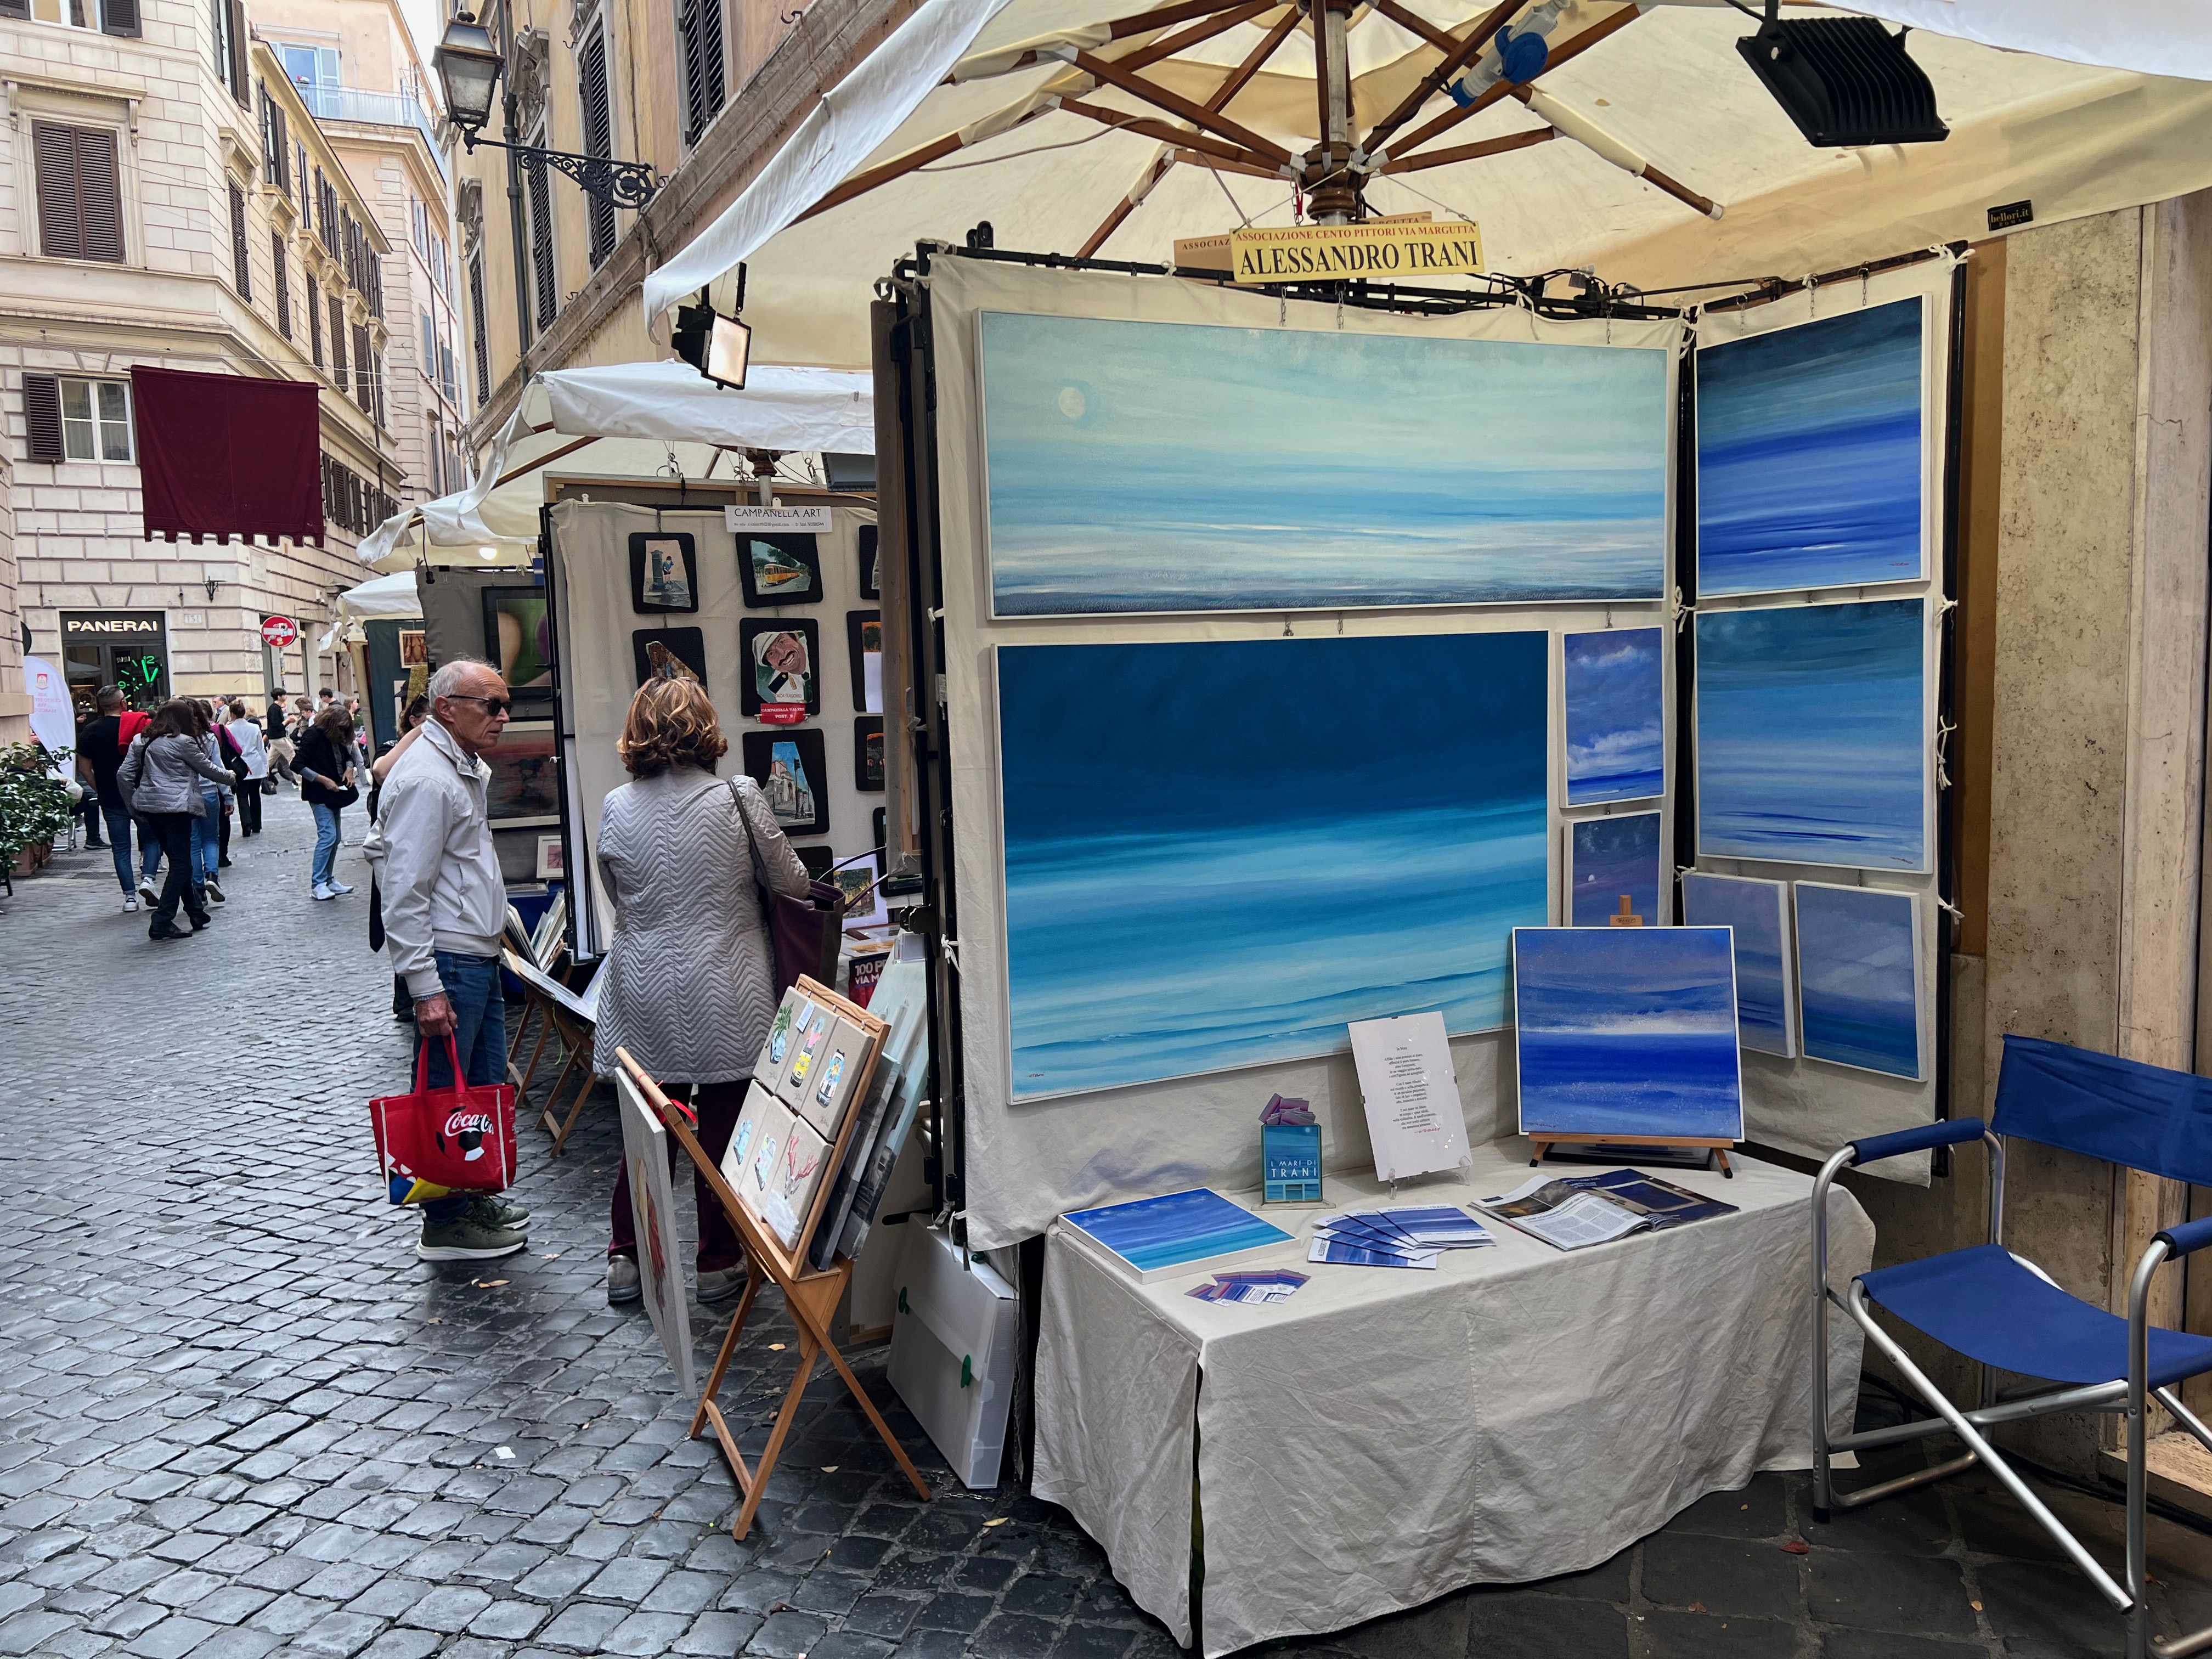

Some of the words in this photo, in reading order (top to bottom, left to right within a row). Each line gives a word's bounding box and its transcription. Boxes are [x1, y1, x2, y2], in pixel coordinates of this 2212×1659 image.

[1990, 208, 2029, 223] bellori.it
[1999, 218, 2022, 227] ROMA
[1236, 230, 1313, 241] ASSOCIAZIONE
[1316, 229, 1351, 239] CENTO
[1355, 228, 1396, 237] PITTORI
[1399, 227, 1417, 235] VIA
[1418, 225, 1475, 235] MARGUTTA
[1182, 238, 1231, 250] ASSOCIAZ
[1240, 243, 1399, 275] ALESSANDRO
[1404, 241, 1479, 268] TRANI
[734, 508, 800, 517] CAMPANELLA
[803, 508, 821, 517] ART
[67, 620, 158, 632] PANERAI
[855, 962, 873, 976] 100
[855, 975, 870, 985] VIA
[871, 973, 879, 983] M
[1271, 1167, 1316, 1178] TRANI
